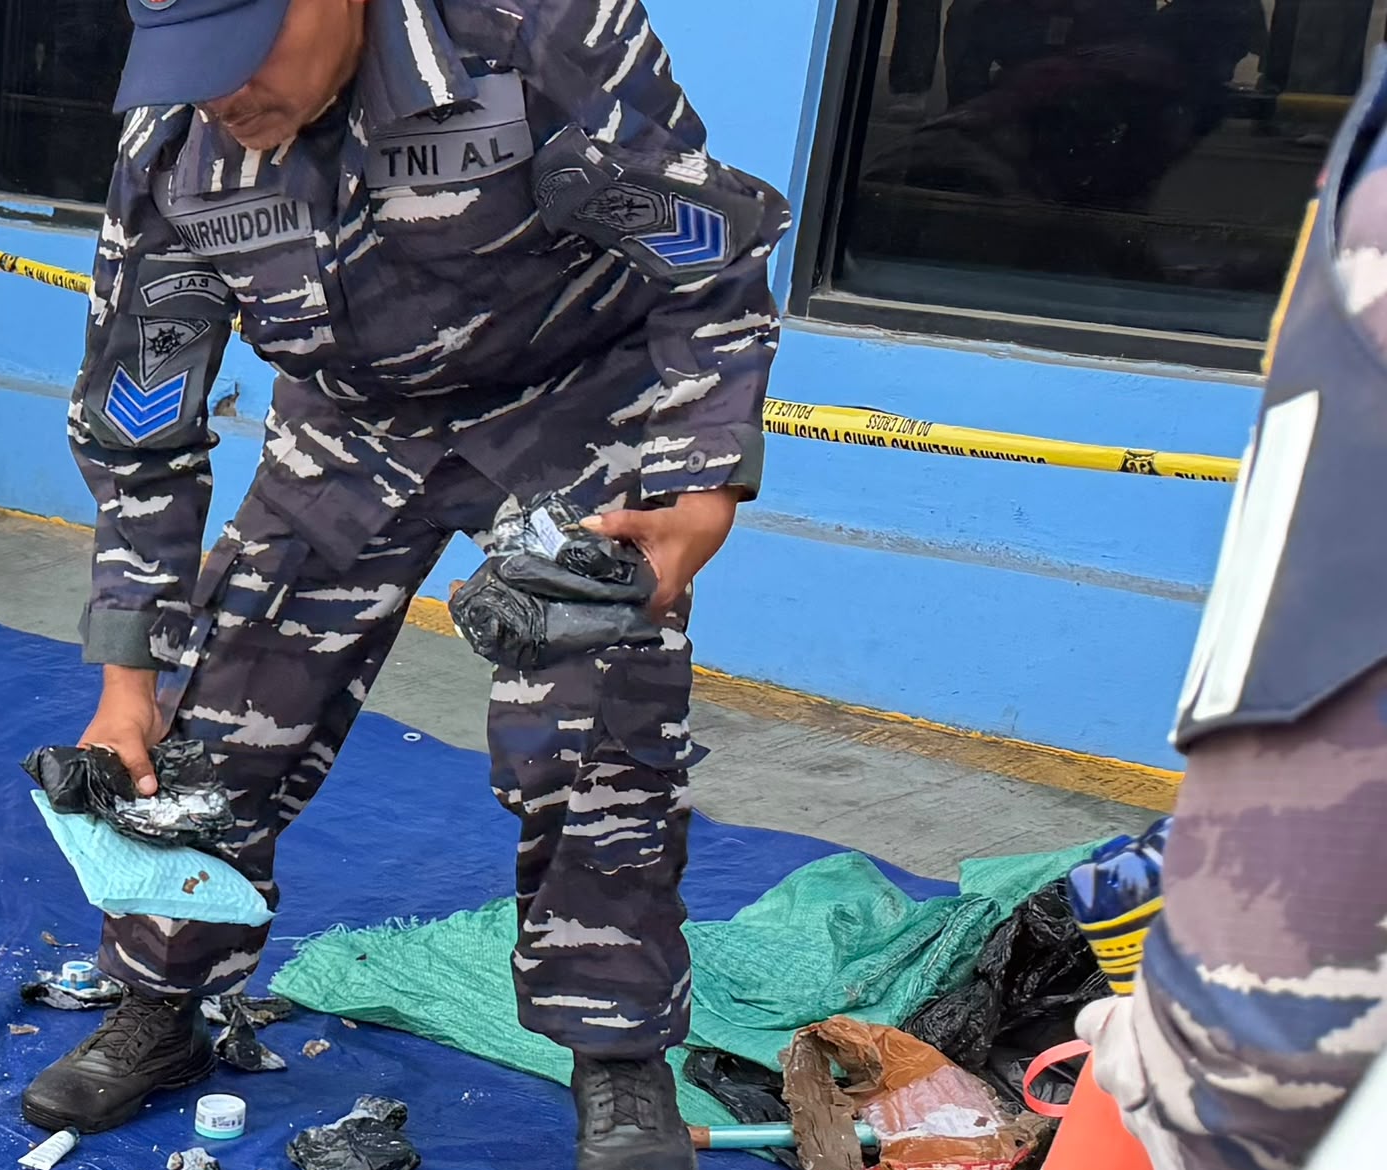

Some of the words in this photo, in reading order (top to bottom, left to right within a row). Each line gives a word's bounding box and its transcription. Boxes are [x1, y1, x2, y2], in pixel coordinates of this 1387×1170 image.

[380, 144, 440, 178] TNI
[460, 137, 515, 172] AL
[175, 200, 300, 250] NURHUDDIN
[865, 412, 897, 433] CROSS
[897, 418, 917, 435] NOT
[916, 421, 934, 438] DO
